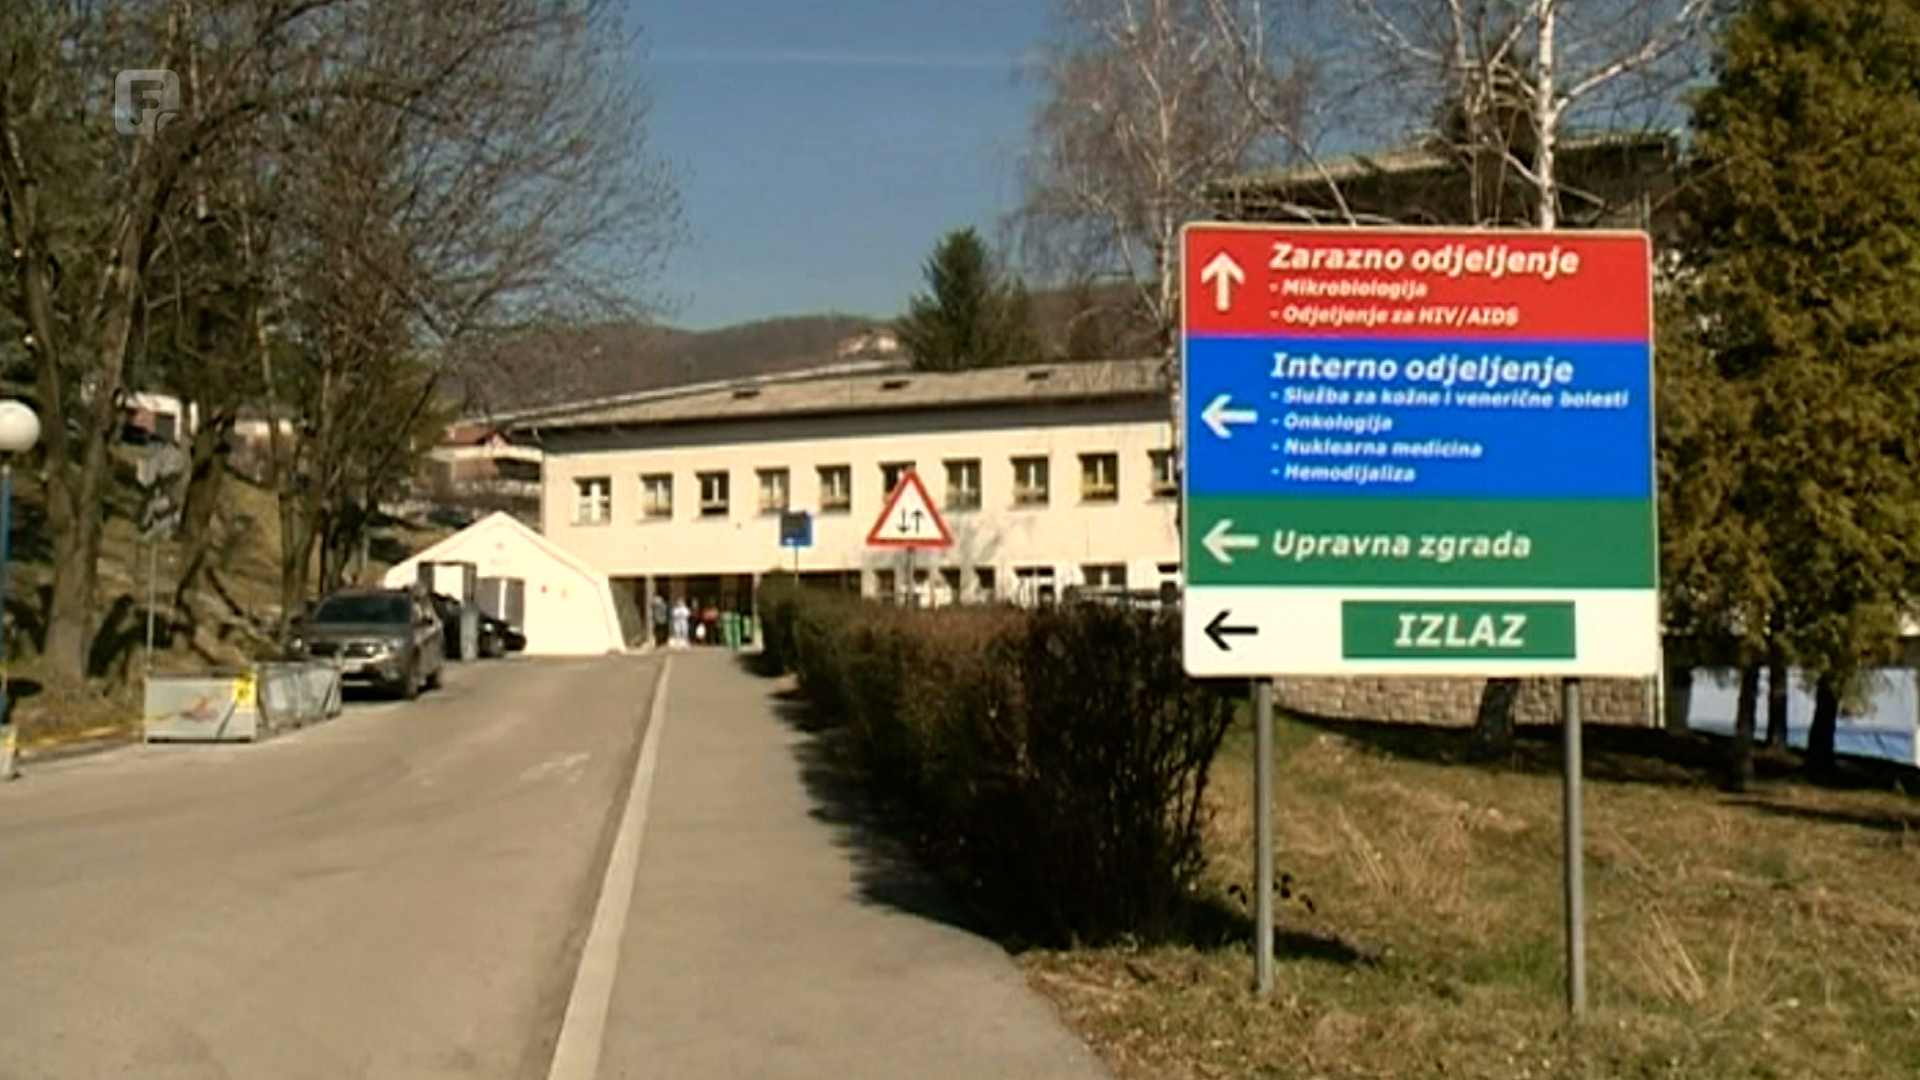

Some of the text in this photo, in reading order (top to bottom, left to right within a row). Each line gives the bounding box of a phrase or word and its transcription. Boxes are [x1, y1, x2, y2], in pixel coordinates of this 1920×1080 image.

[1270, 243, 1579, 280] Zarazno odjeljenje
[1281, 278, 1428, 300] Mikrobiologija
[1283, 305, 1388, 328] Odjeljenje
[1392, 309, 1413, 325] za
[1418, 306, 1519, 326] HIV/AIDS
[1270, 352, 1574, 389] Interno odjeljenje
[1354, 391, 1376, 405] za
[1381, 387, 1443, 406] kožne
[1560, 389, 1630, 408] bolesti
[1283, 412, 1394, 435] Onkologija
[1284, 437, 1389, 457] Nuklearna
[1391, 439, 1483, 458] medicina
[1284, 463, 1417, 485] Hemodijaliza
[1272, 530, 1532, 562] Upravna zgrada
[1395, 614, 1528, 648] IZLAZ
